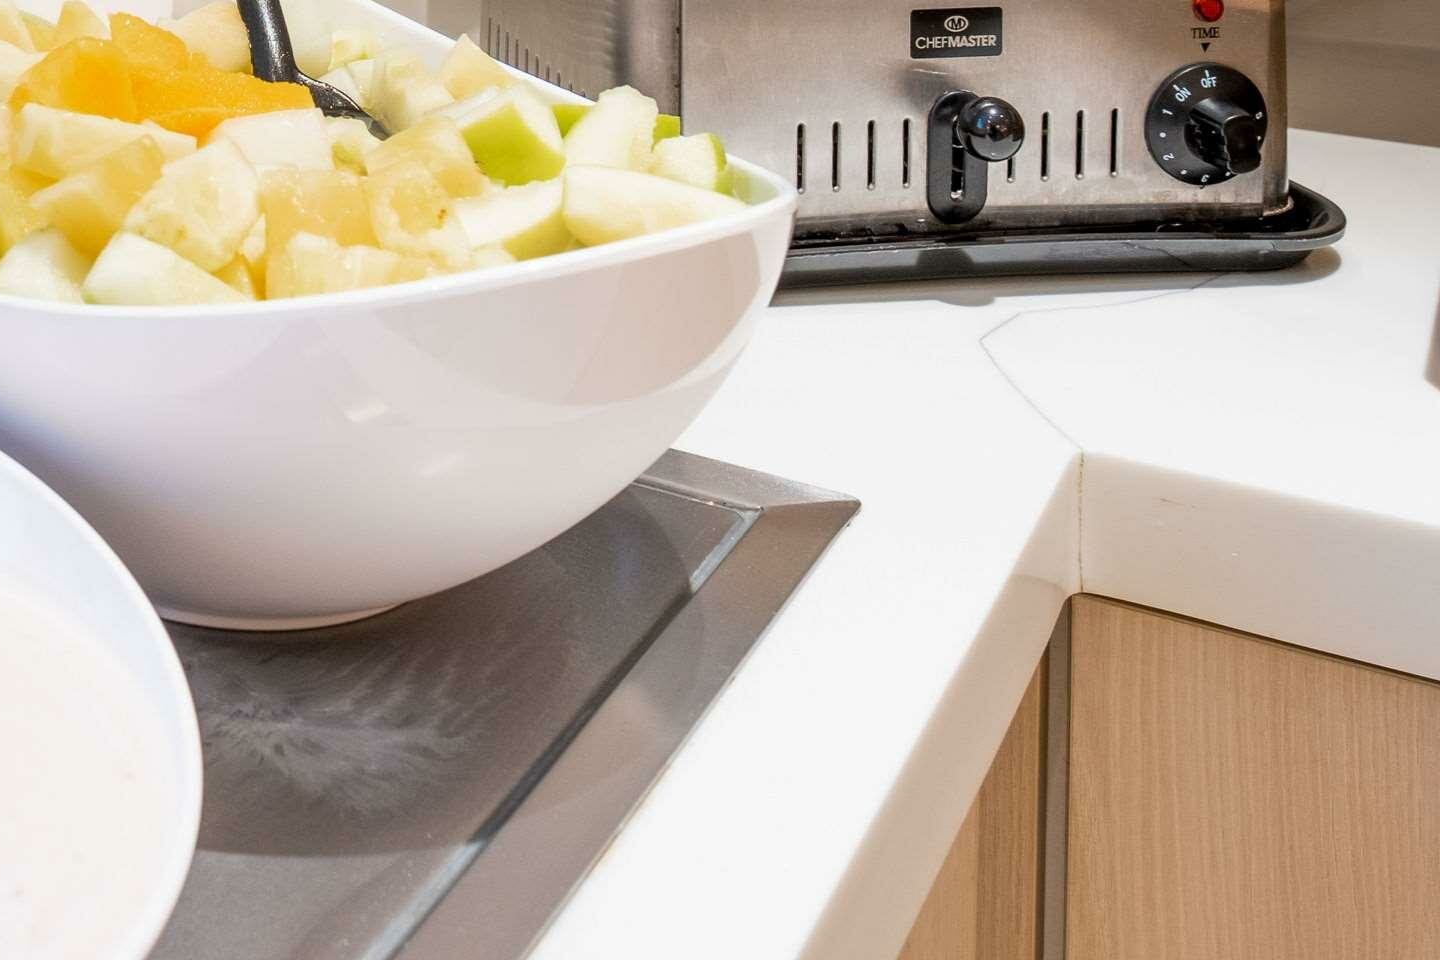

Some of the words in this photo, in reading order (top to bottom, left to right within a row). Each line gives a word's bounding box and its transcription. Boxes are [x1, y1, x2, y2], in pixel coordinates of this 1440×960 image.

[1191, 26, 1221, 39] TIME
[915, 34, 997, 50] CHEFMASTER
[1200, 76, 1217, 89] OFF
[1175, 87, 1192, 102] ON
